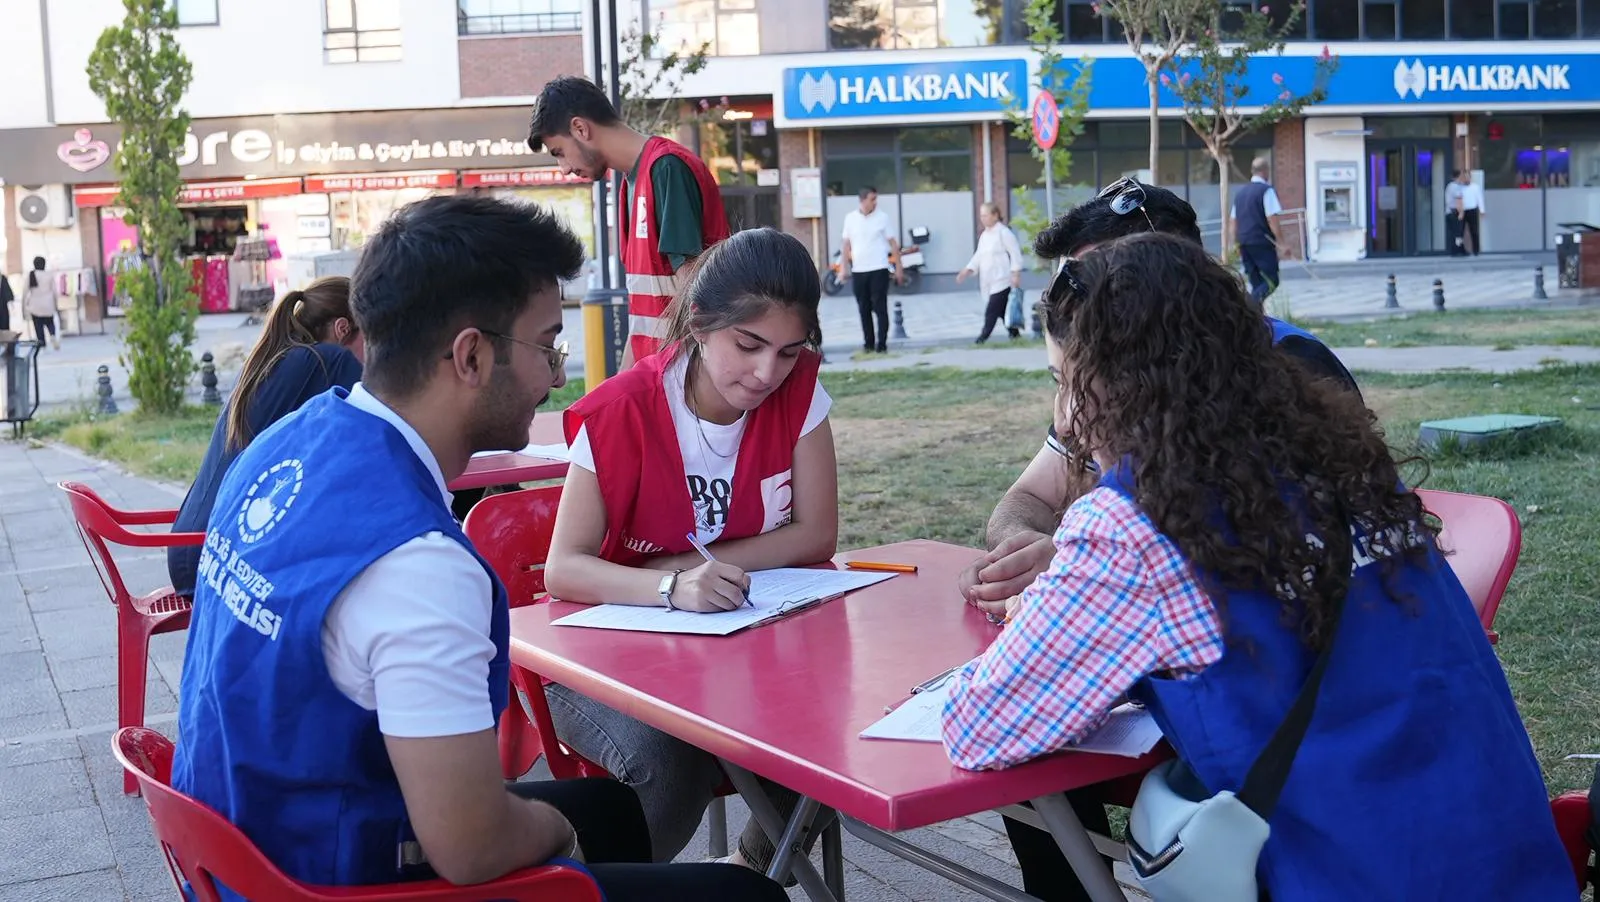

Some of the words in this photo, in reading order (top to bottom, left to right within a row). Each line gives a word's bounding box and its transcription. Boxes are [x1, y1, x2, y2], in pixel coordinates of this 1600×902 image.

[839, 71, 1010, 105] HALKBANK
[1427, 64, 1571, 92] HALKBANK
[449, 140, 475, 157] Ev
